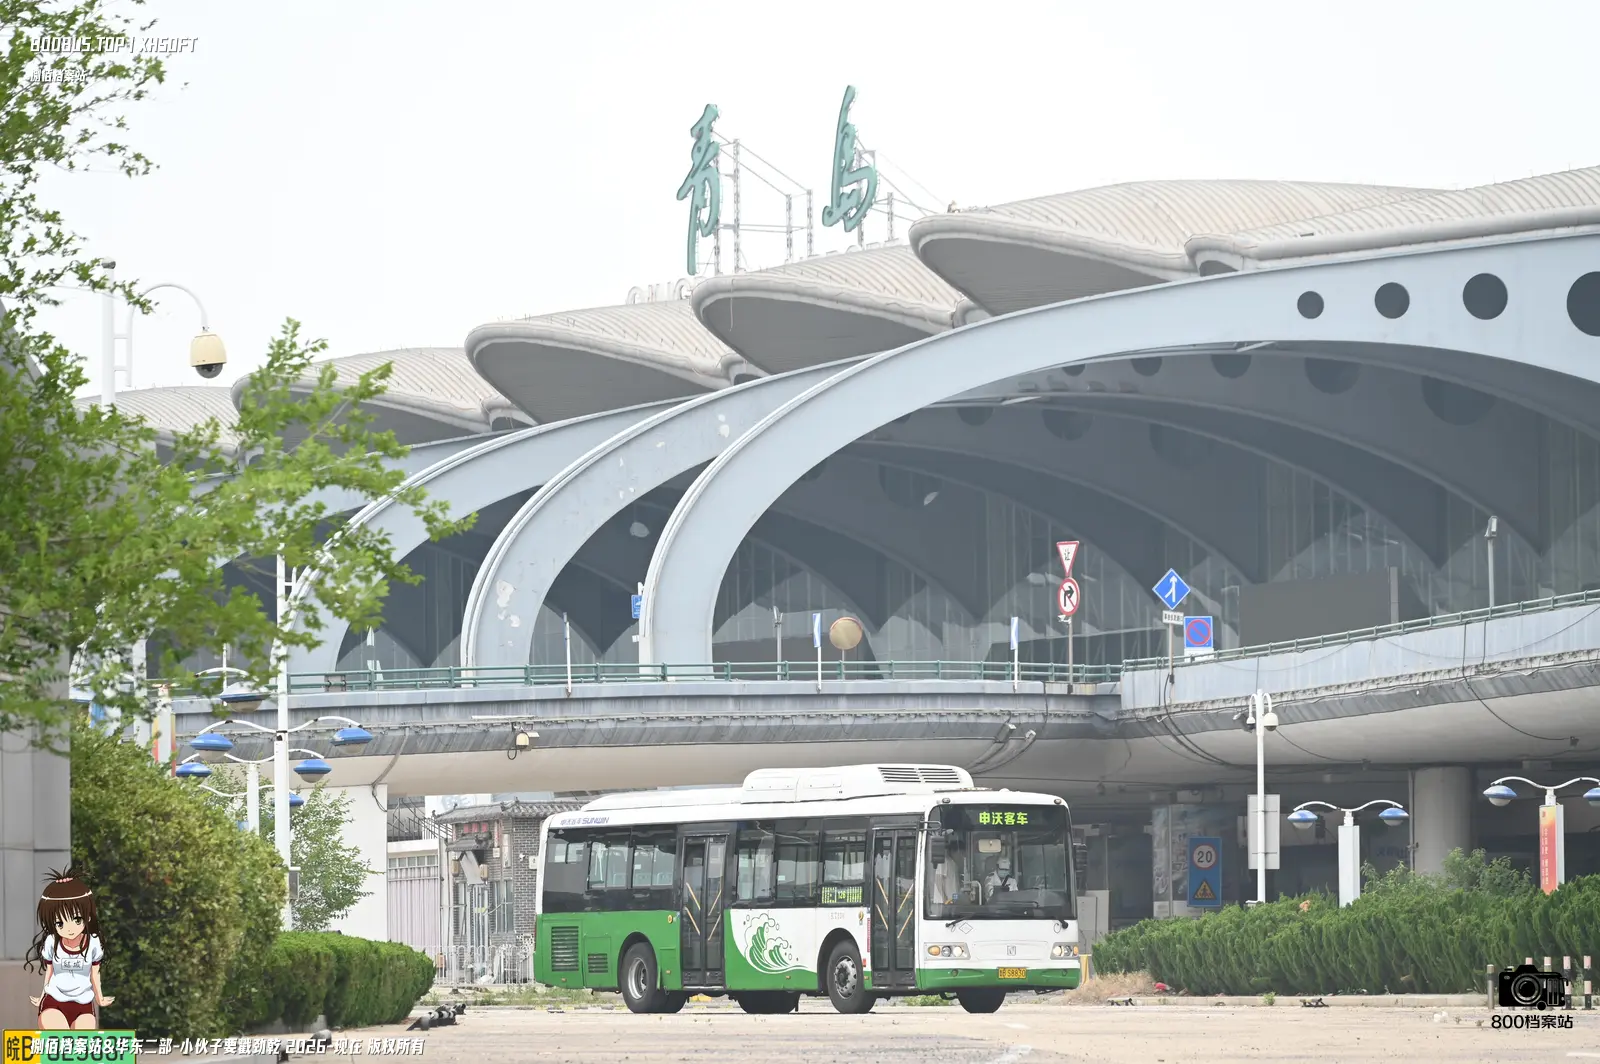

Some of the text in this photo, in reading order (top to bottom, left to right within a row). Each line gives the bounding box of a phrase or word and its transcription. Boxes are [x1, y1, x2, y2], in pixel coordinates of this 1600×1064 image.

[979, 811, 1029, 825] 申沃客车
[1197, 850, 1213, 863] 20
